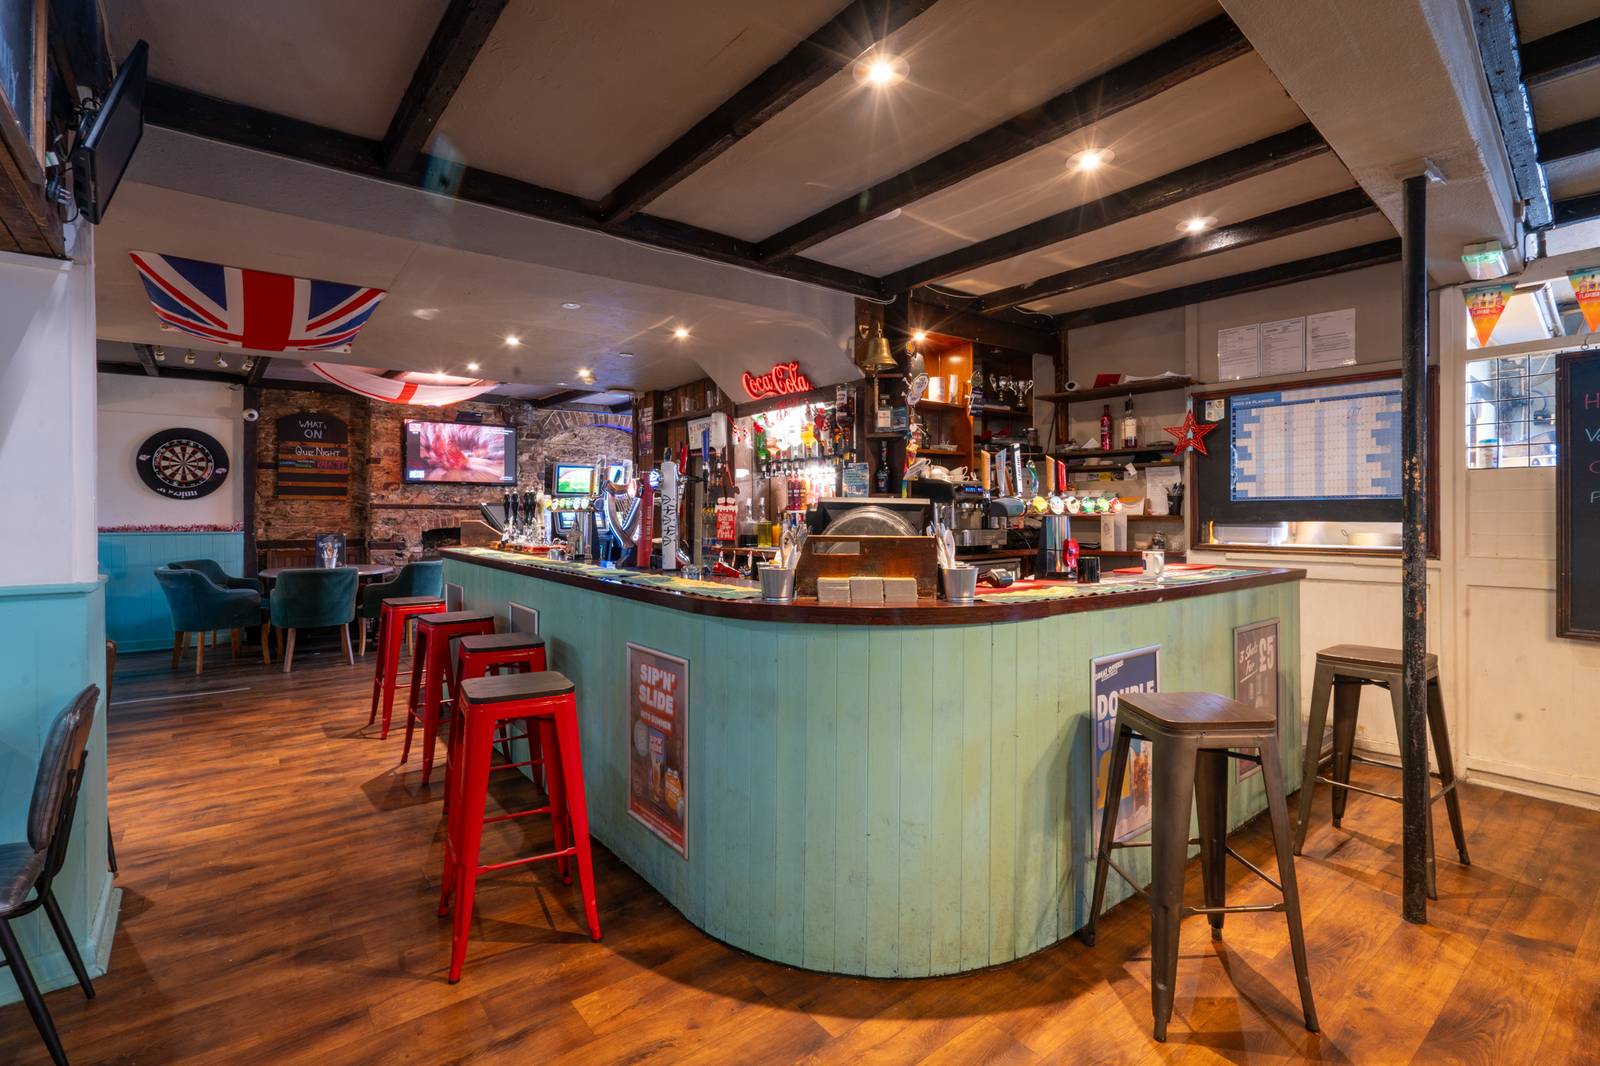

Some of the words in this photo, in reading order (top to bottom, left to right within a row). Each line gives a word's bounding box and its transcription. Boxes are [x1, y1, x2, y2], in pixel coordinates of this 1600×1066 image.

[304, 428, 323, 439] ON
[1258, 634, 1275, 673] £5
[639, 684, 674, 716] SLIDE
[1097, 680, 1155, 722] DOE
